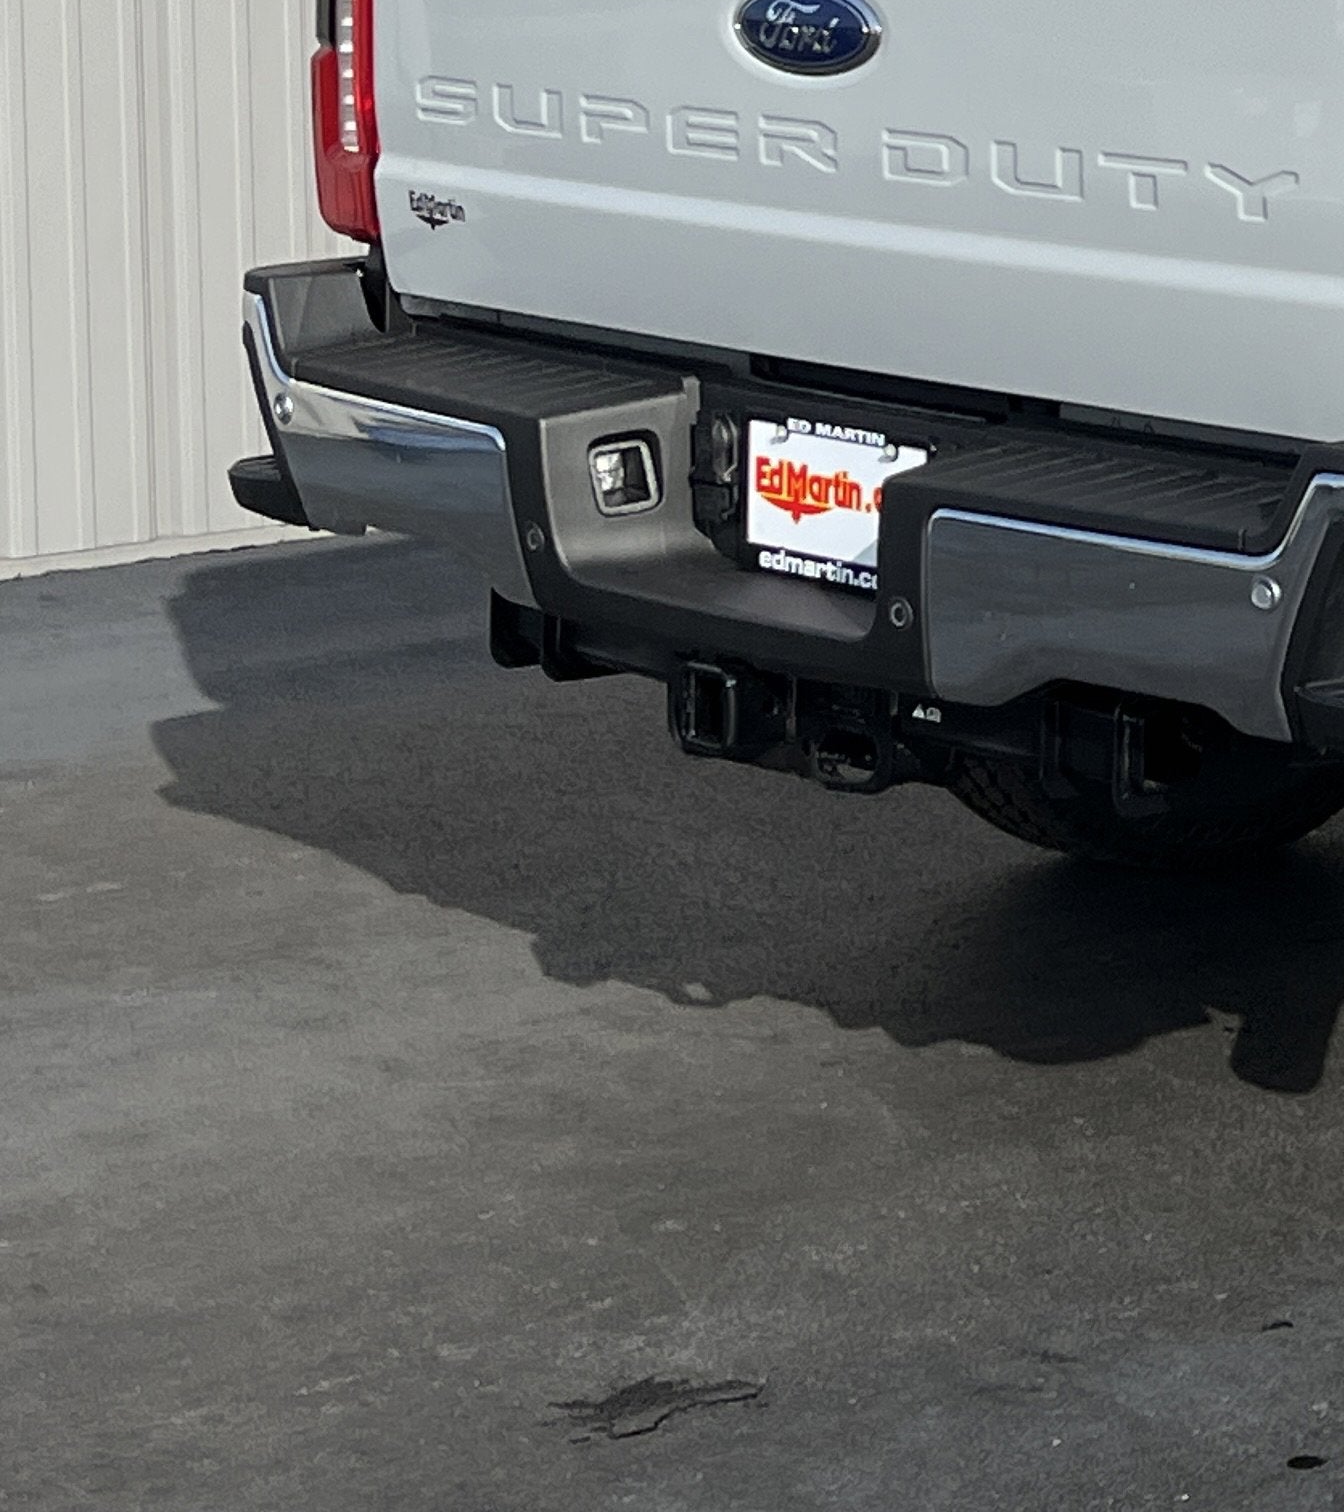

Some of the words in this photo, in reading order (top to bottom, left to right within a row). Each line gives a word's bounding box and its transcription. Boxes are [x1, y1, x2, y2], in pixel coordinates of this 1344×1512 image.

[414, 74, 838, 173] SUPER
[881, 126, 1301, 223] DUTY
[786, 417, 812, 434] ED
[815, 422, 886, 447] MARTIN
